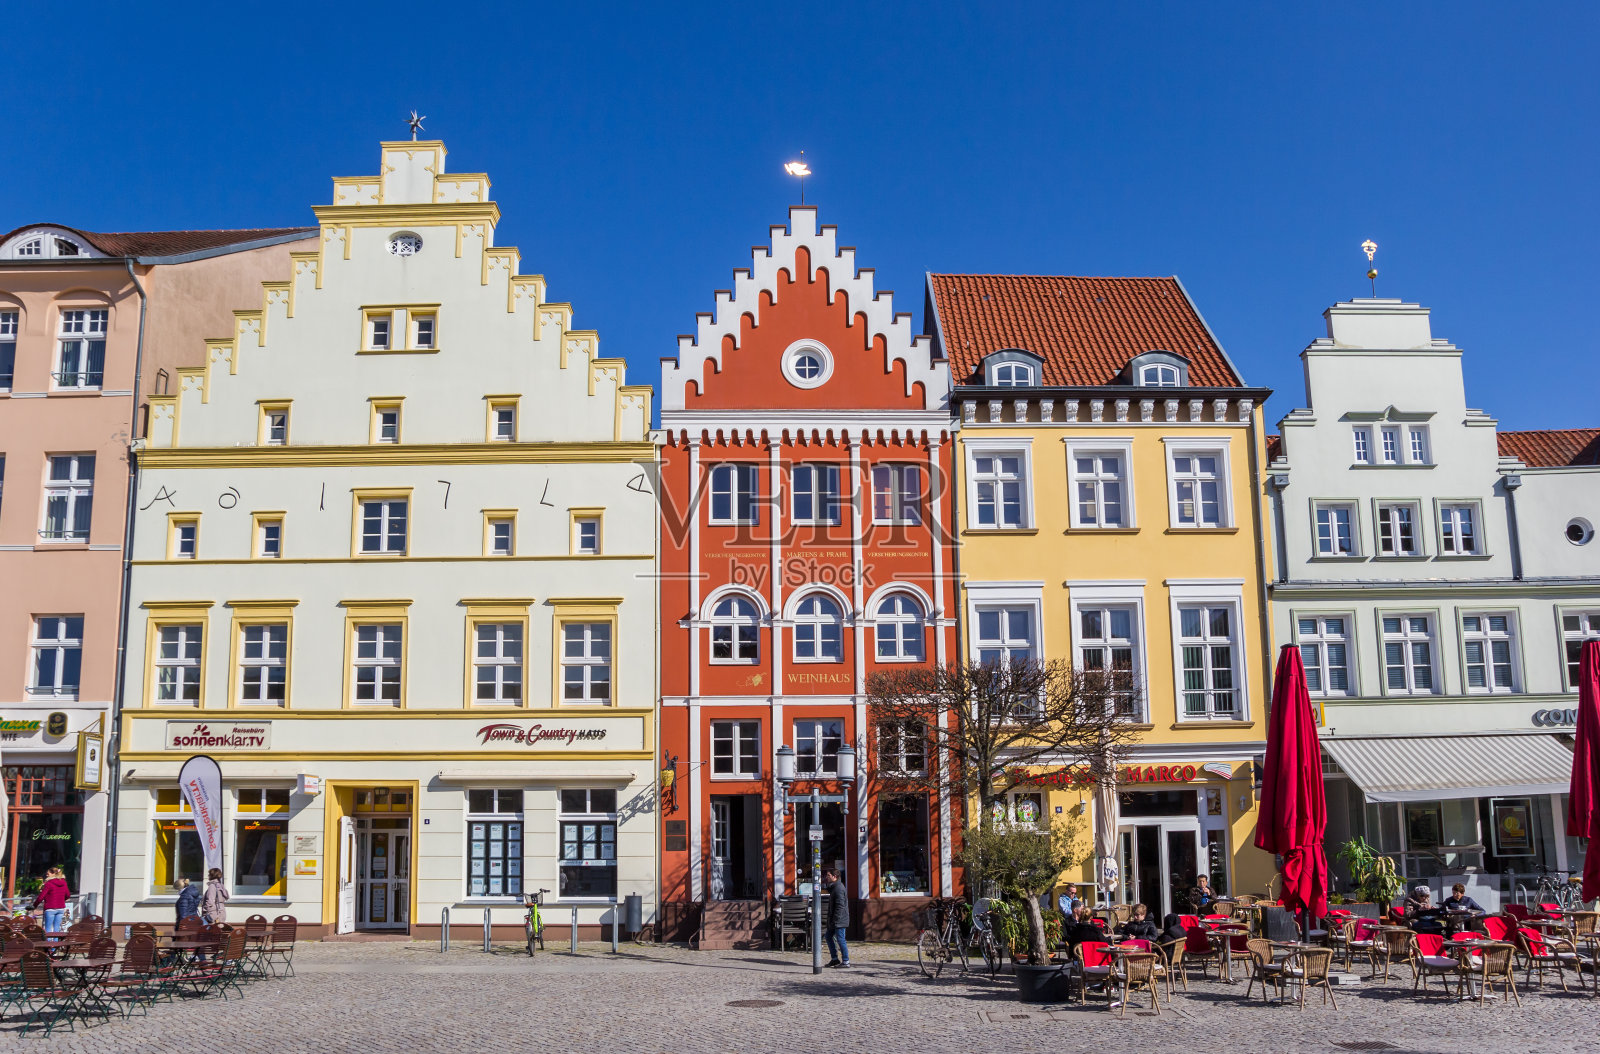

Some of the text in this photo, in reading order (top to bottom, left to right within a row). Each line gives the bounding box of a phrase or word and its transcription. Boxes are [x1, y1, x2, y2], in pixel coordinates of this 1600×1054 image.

[787, 673, 851, 684] WEINHAUS
[0, 716, 40, 730] azza
[173, 735, 265, 747] sonnenklar.TV
[477, 723, 523, 745] Town
[527, 723, 577, 746] Country
[579, 729, 606, 738] HAUS
[1126, 764, 1197, 782] MARCO
